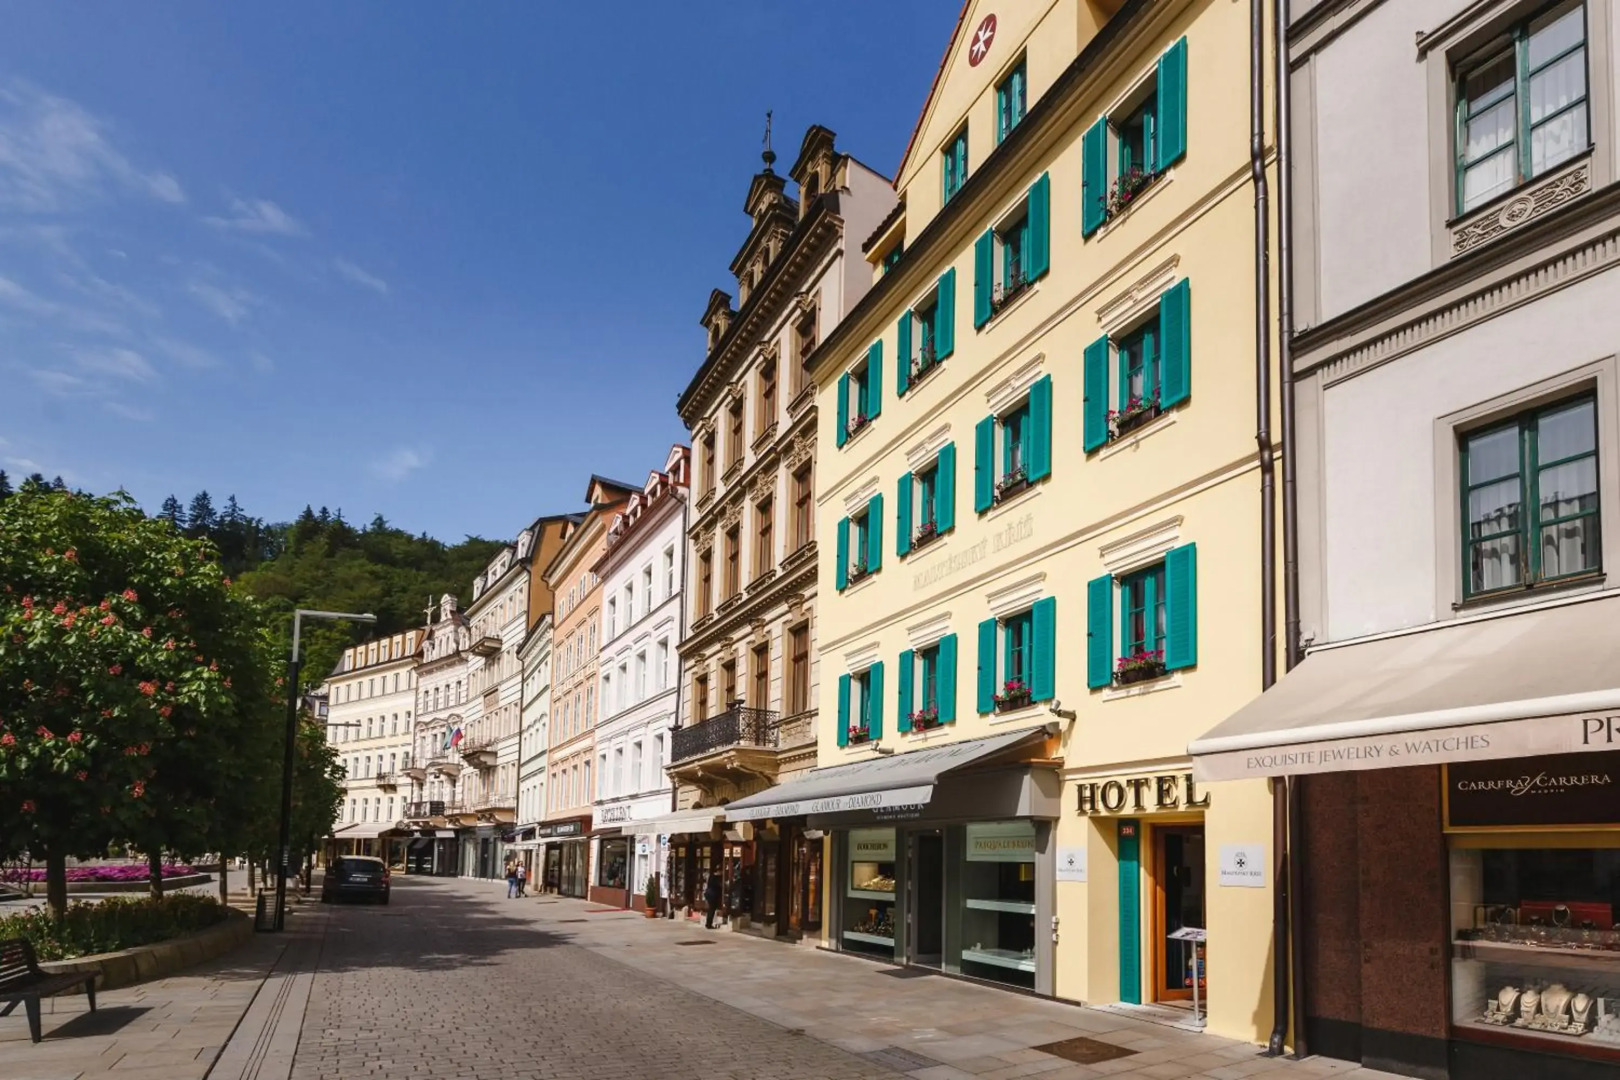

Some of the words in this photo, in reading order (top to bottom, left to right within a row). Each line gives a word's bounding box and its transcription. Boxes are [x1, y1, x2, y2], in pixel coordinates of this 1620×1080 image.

[1246, 751, 1315, 769] EXQUISITE
[1318, 745, 1383, 765] JEWELRY
[1388, 744, 1400, 756] &
[1405, 734, 1490, 754] WATCHES
[1075, 773, 1209, 812] HOTEL
[1536, 774, 1612, 787] CARRERA
[849, 794, 882, 809] DIAMOND
